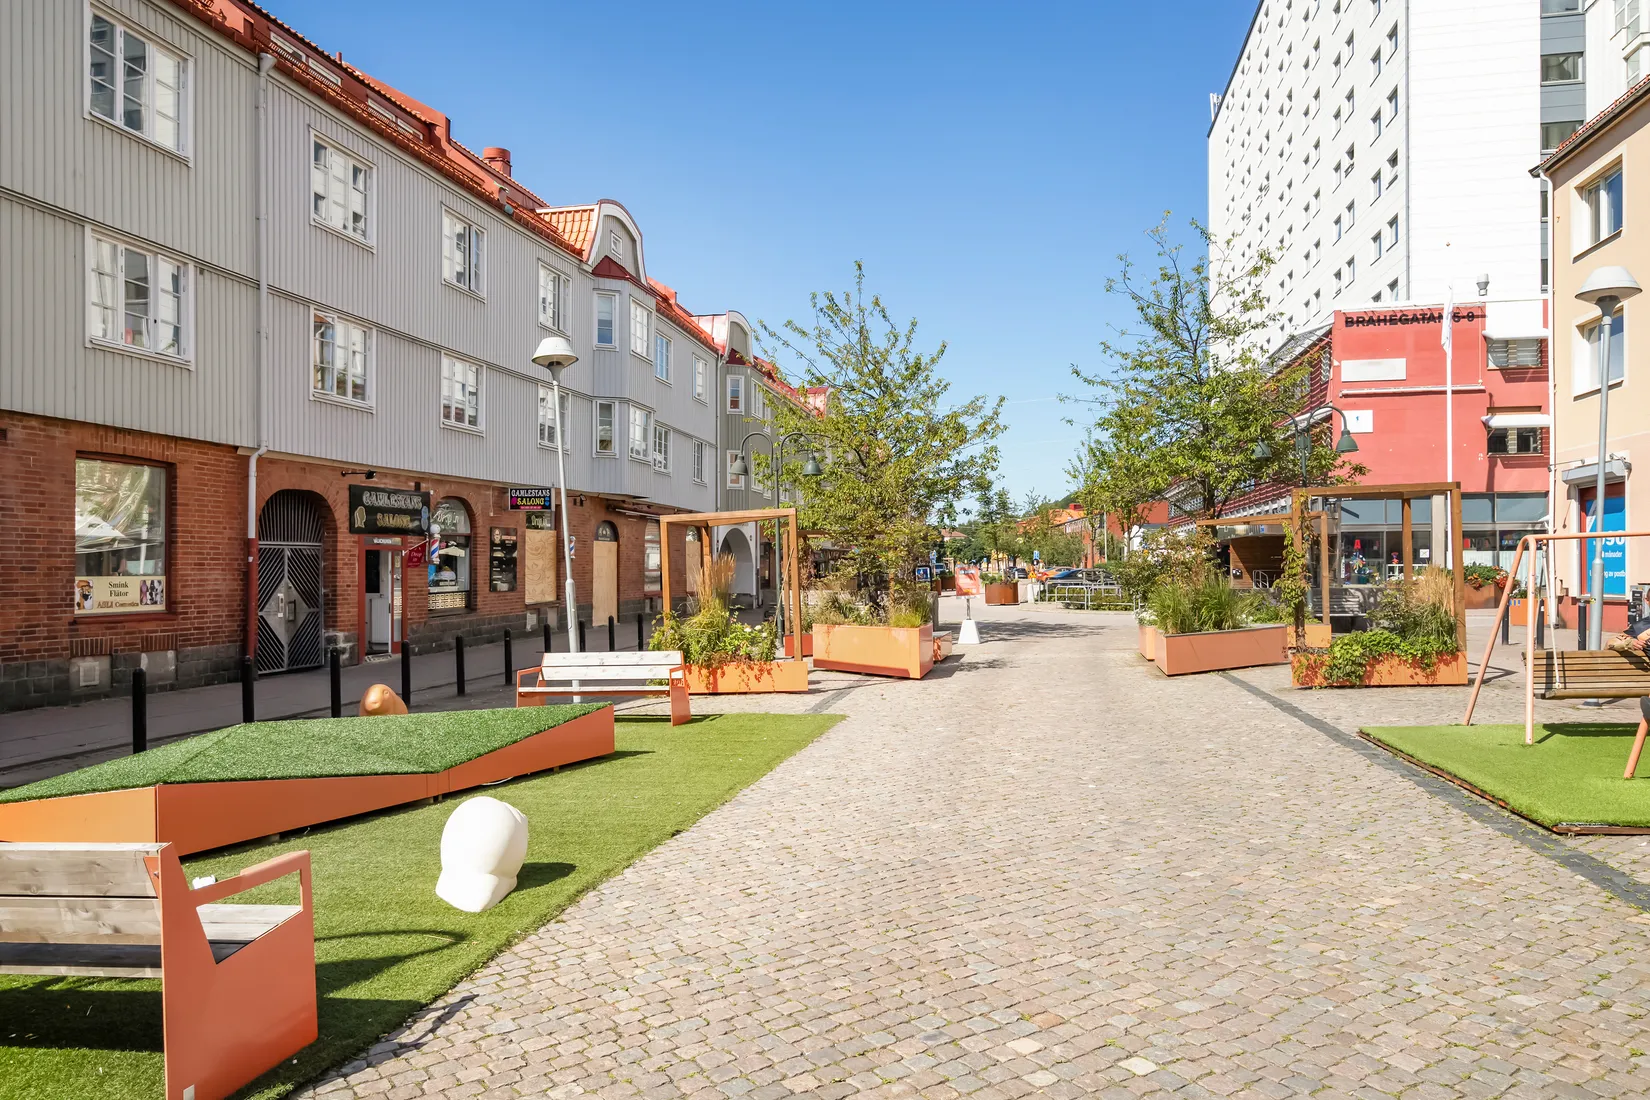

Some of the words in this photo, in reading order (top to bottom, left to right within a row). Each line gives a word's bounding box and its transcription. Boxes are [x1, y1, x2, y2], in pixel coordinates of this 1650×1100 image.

[511, 489, 551, 497] GAMLESTANS
[363, 491, 422, 510] GAMLESTANS
[517, 497, 545, 506] SALONG
[376, 512, 411, 529] SALONG
[108, 580, 129, 589] Smink
[109, 589, 129, 598] Flätor
